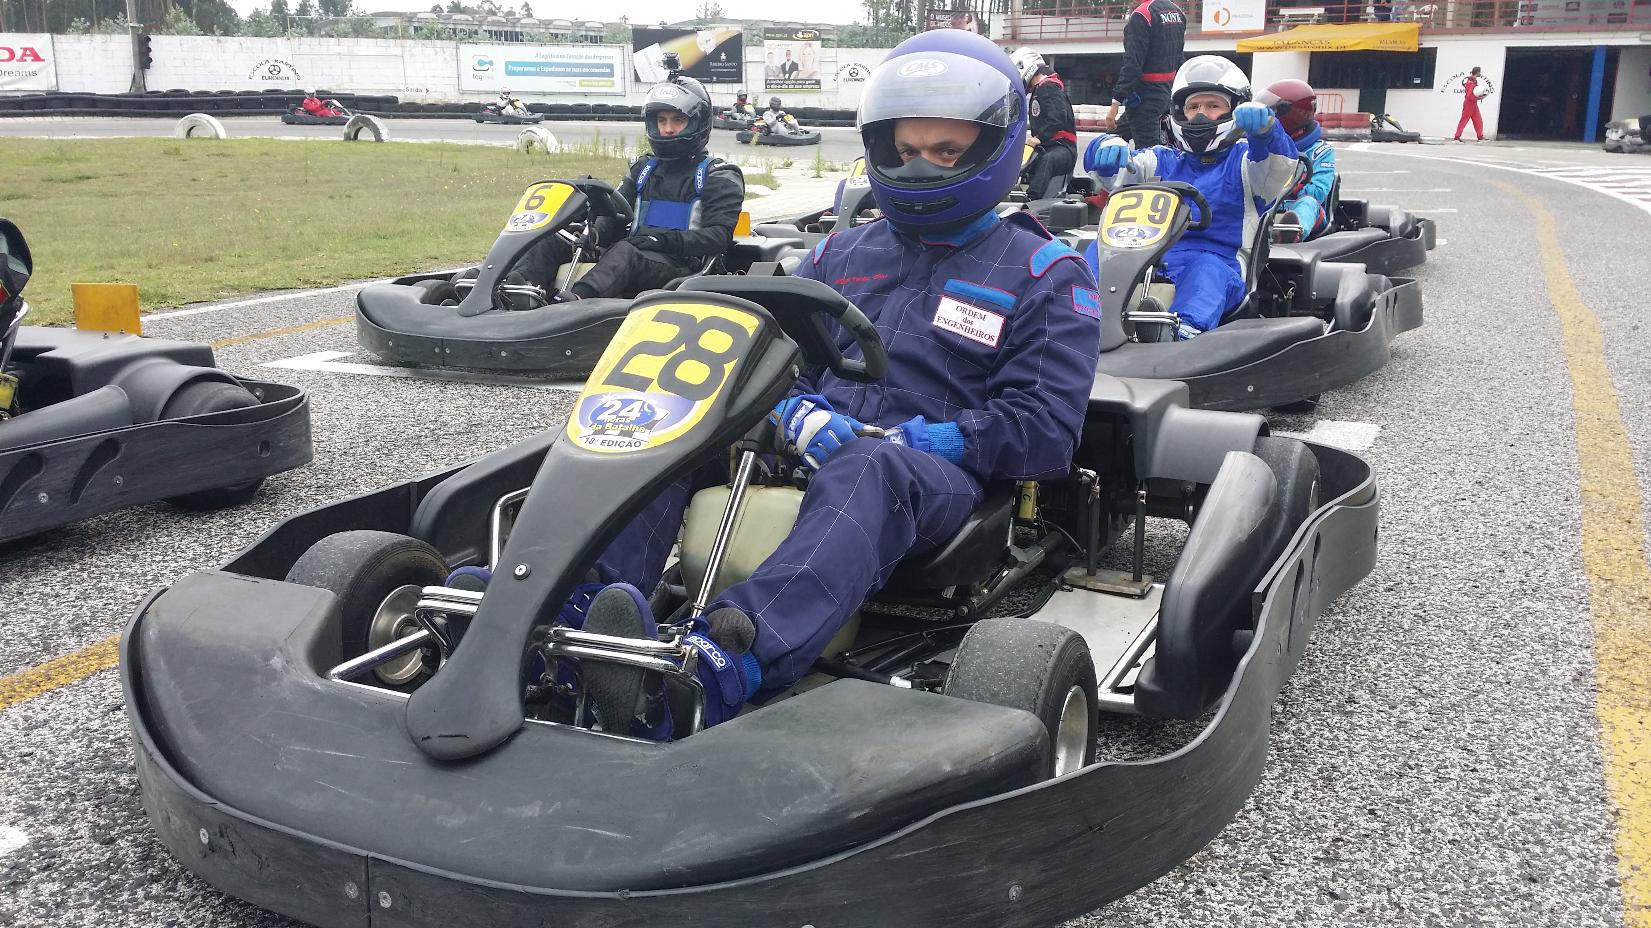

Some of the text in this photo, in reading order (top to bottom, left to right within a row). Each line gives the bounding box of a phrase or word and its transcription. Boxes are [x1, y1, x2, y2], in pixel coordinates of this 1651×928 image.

[524, 184, 553, 211] 6
[1111, 192, 1172, 225] 29
[955, 305, 987, 321] ORDEM
[962, 316, 974, 325] dos
[936, 315, 996, 343] ENGENHEIROS
[602, 309, 752, 401] 28
[596, 398, 645, 421] 24
[604, 422, 646, 433] Batalha
[599, 439, 643, 449] EDIÇÃO
